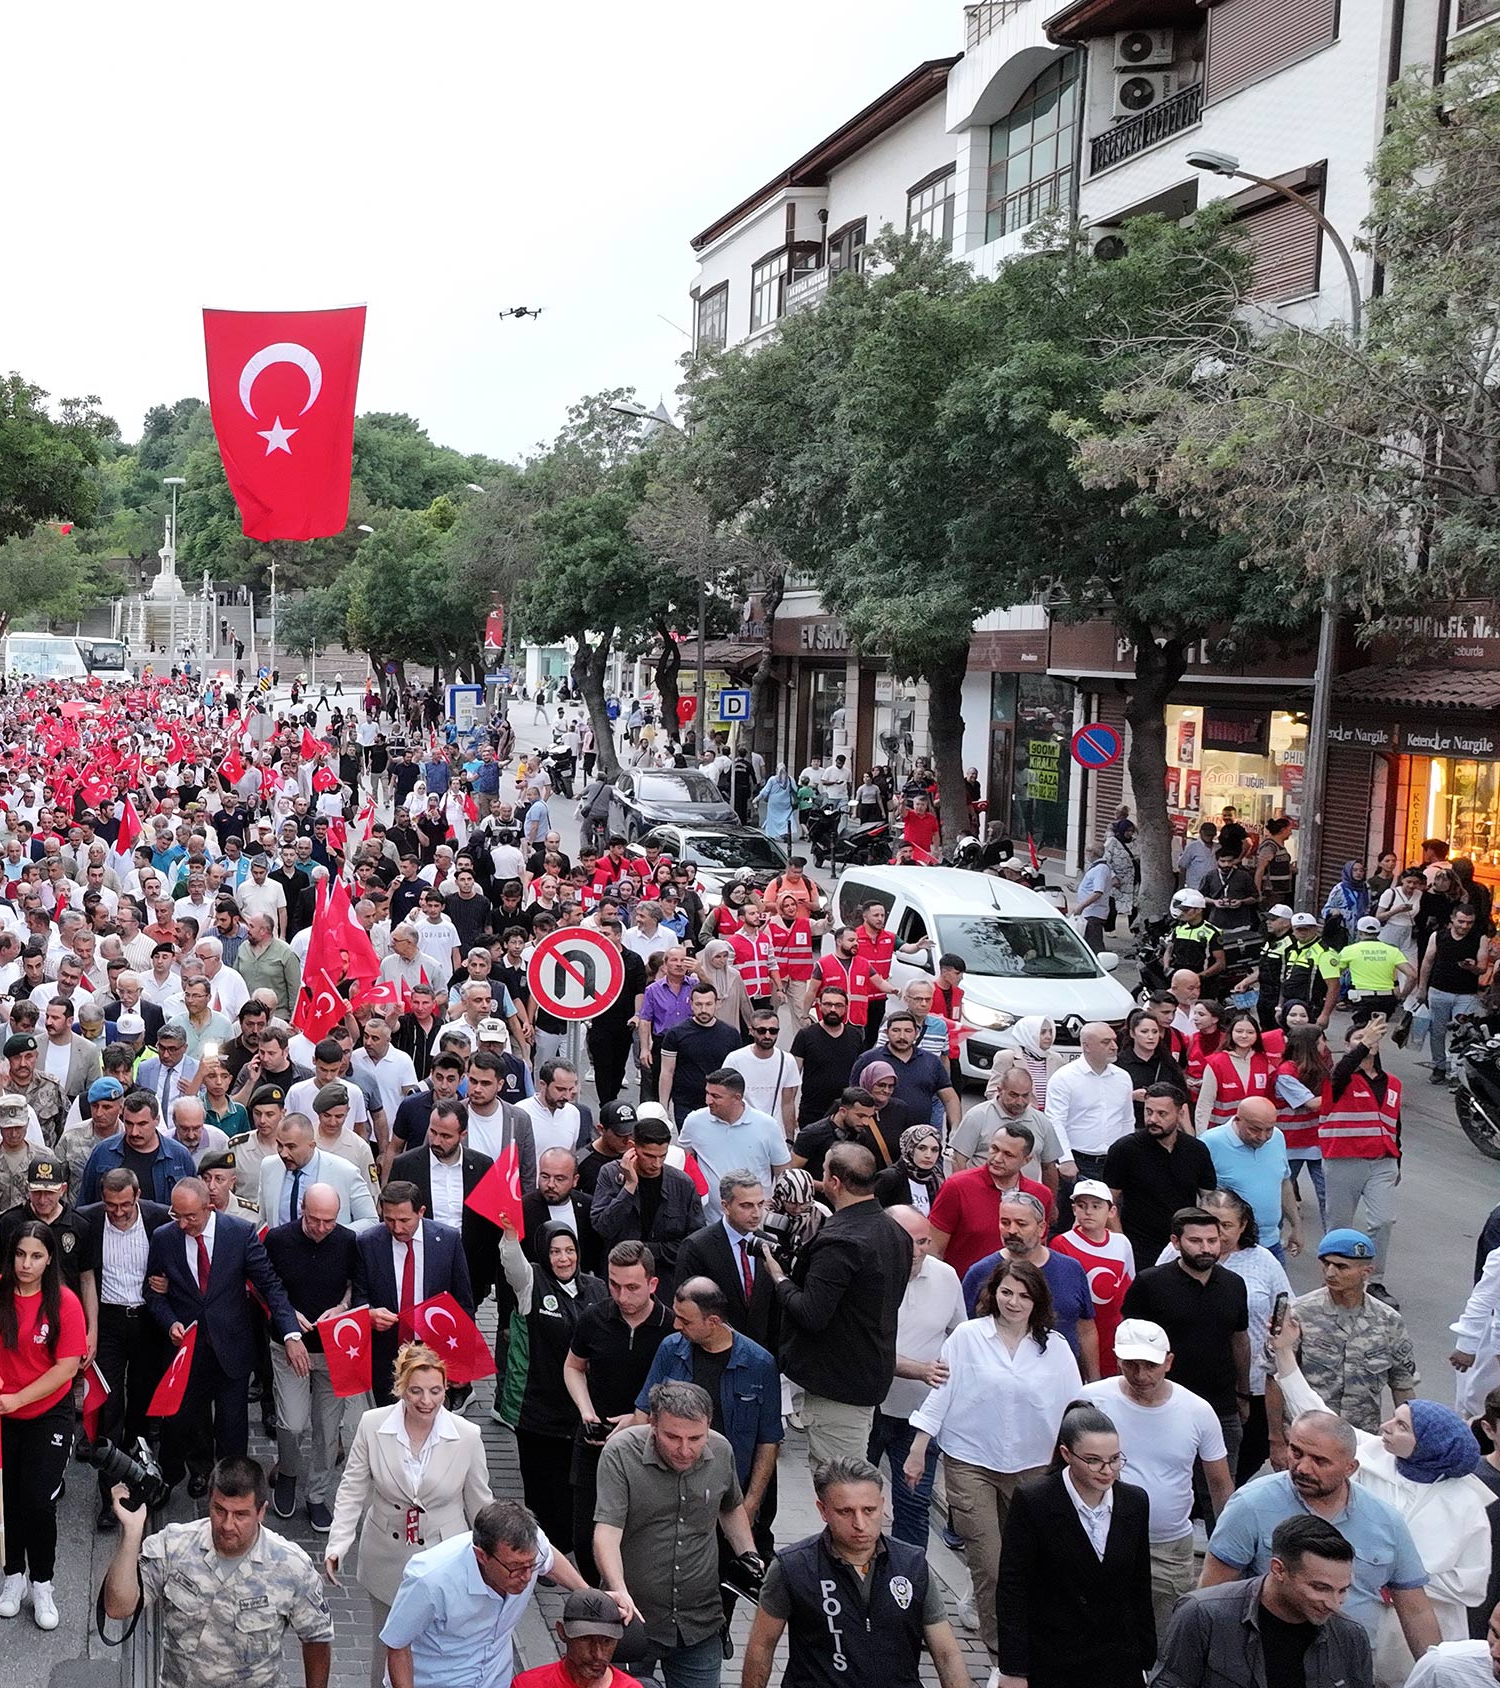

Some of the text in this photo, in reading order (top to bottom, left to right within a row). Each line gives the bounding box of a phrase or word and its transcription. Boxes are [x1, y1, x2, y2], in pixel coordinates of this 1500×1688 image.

[728, 697, 742, 714] D
[1354, 728, 1389, 746] Nargile
[1453, 736, 1494, 755] Nargile
